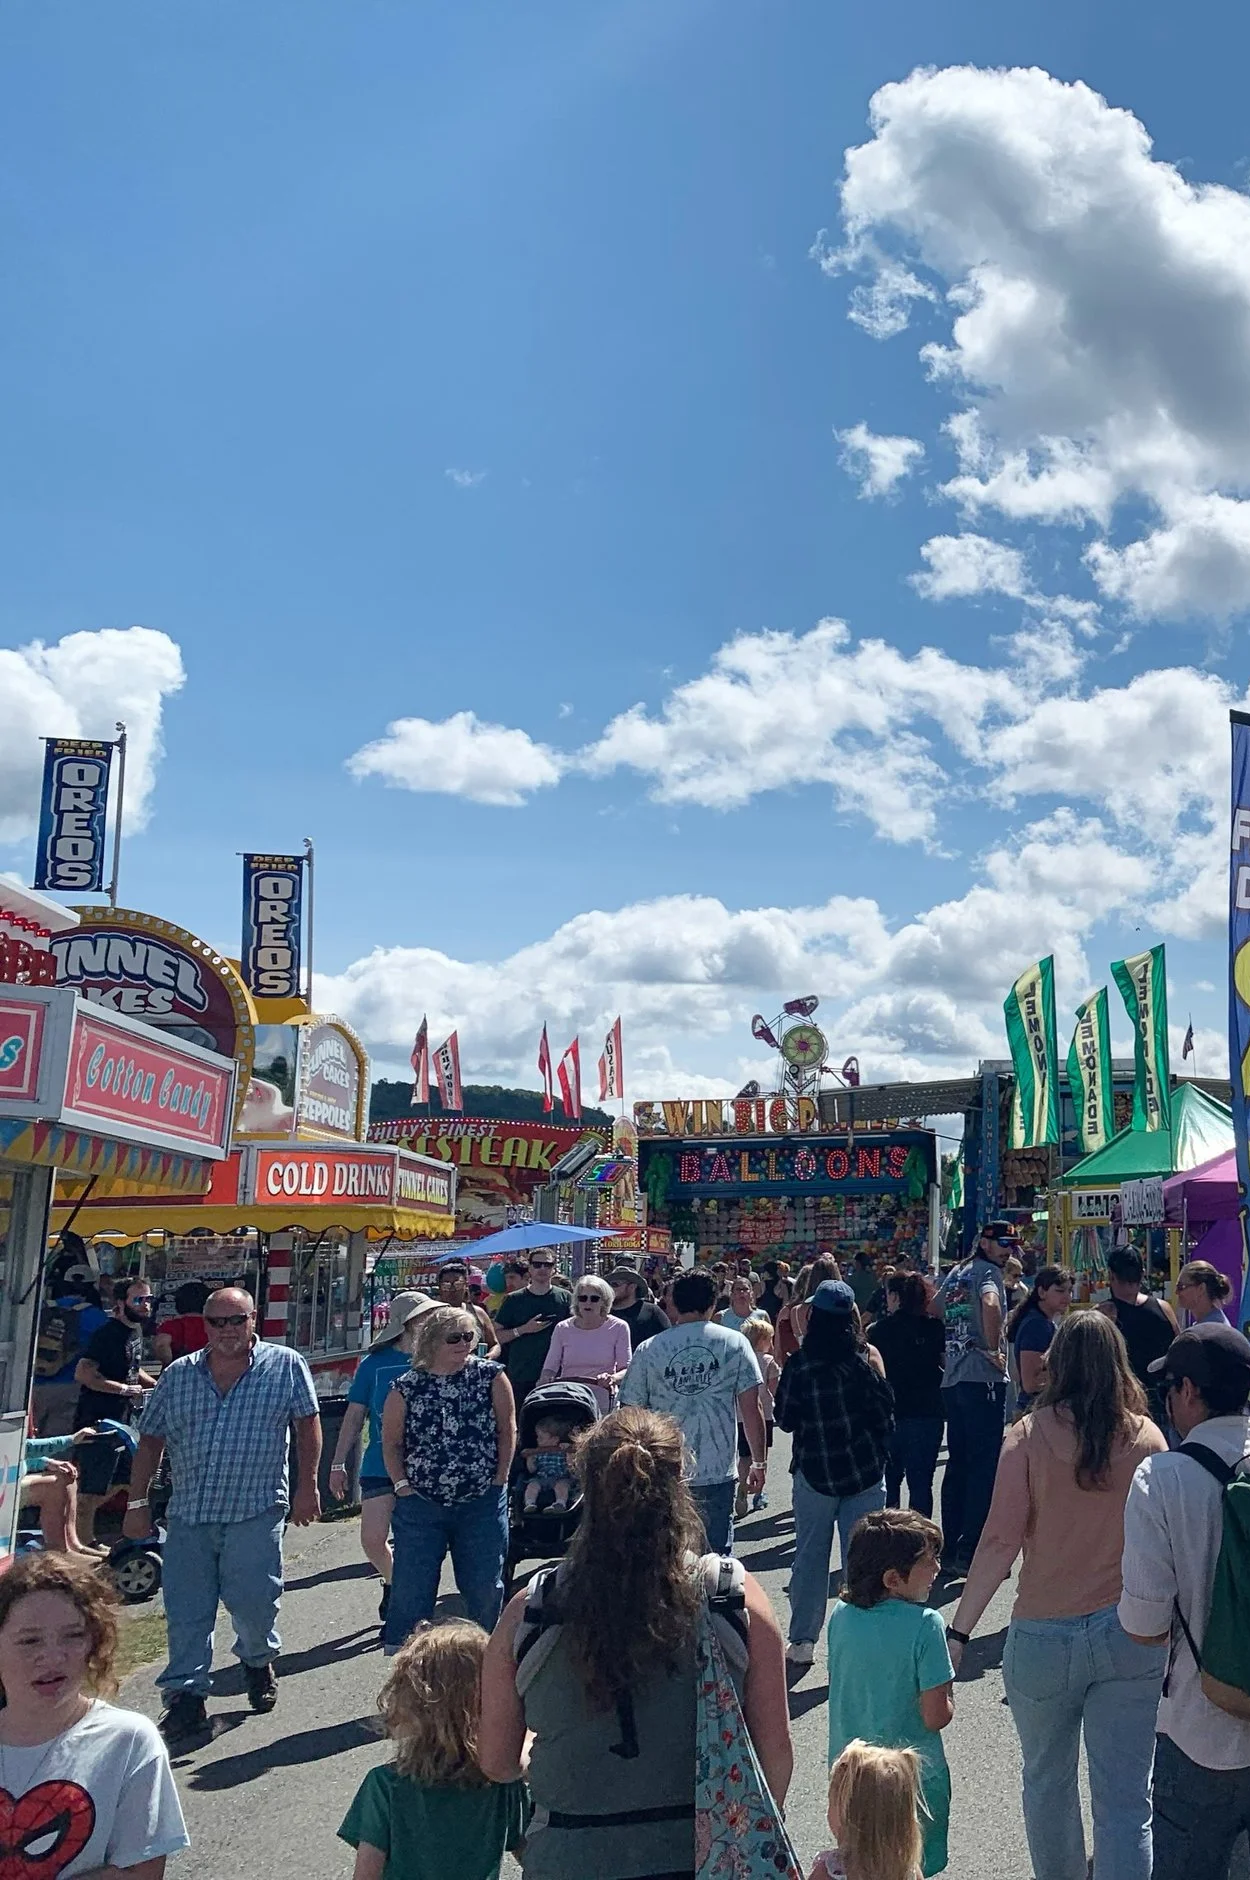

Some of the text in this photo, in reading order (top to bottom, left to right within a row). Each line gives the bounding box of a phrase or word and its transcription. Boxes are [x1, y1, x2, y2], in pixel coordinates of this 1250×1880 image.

[54, 748, 107, 756] FRIED
[56, 740, 103, 748] DEEP
[53, 762, 101, 887] OREOS
[256, 876, 294, 995] OREOS
[52, 937, 206, 1008] NNEL
[86, 1043, 156, 1105] Cotton
[158, 1068, 212, 1130] Candy
[322, 1062, 350, 1089] CAKES
[367, 1122, 499, 1142] PHILLY'S FINEST
[661, 1100, 723, 1137] WIN
[733, 1100, 787, 1134] BIG
[267, 1161, 391, 1197] COLD DRINKS
[680, 1148, 909, 1184] BALLOONS
[399, 1168, 449, 1206] FUNNEL CAKES
